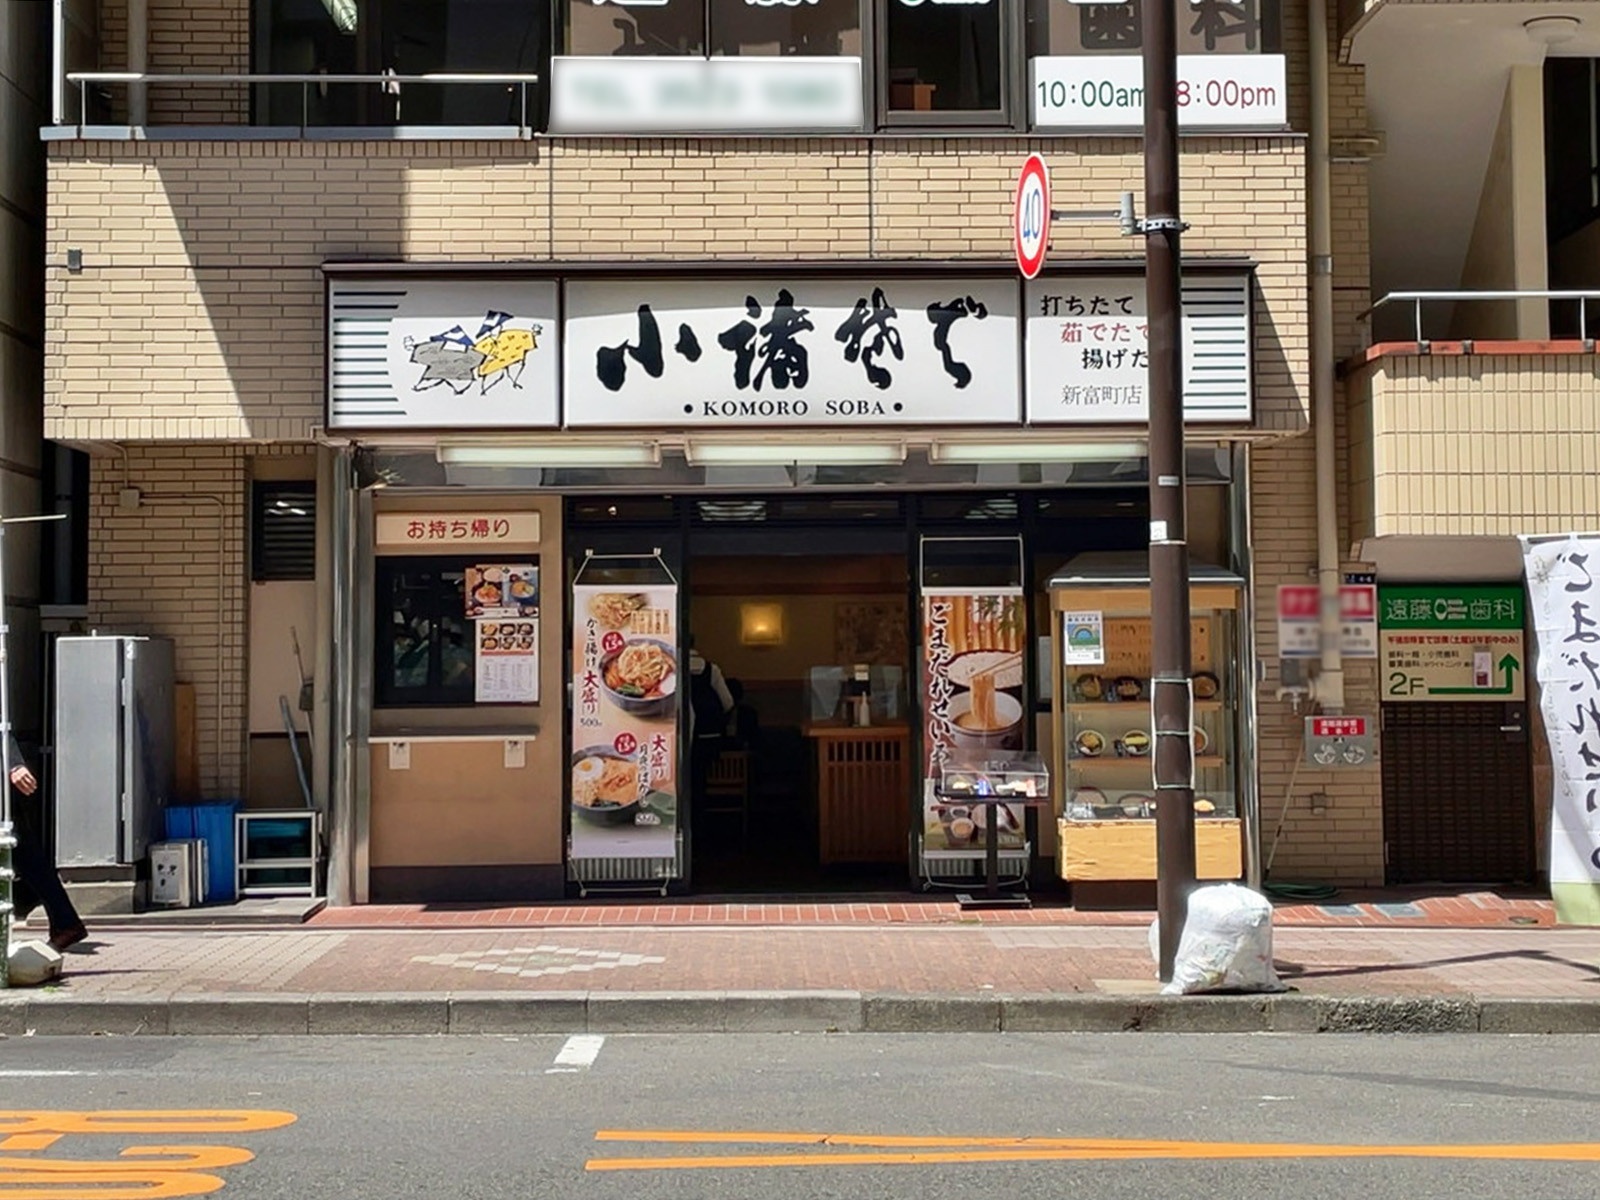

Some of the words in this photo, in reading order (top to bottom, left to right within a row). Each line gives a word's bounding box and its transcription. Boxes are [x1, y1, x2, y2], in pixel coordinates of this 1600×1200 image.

[1038, 80, 1145, 107] 10:00am
[1175, 80, 1276, 109] 8:00pm
[1023, 188, 1041, 243] 40
[1041, 295, 1133, 316] 打ちたて
[1081, 348, 1149, 369] 揚げた
[1061, 385, 1142, 405] 新富町店
[703, 401, 808, 415] KOMORO
[826, 401, 885, 415] SOBA
[407, 519, 510, 539] お持ち帰り
[1389, 672, 1424, 695] 2F
